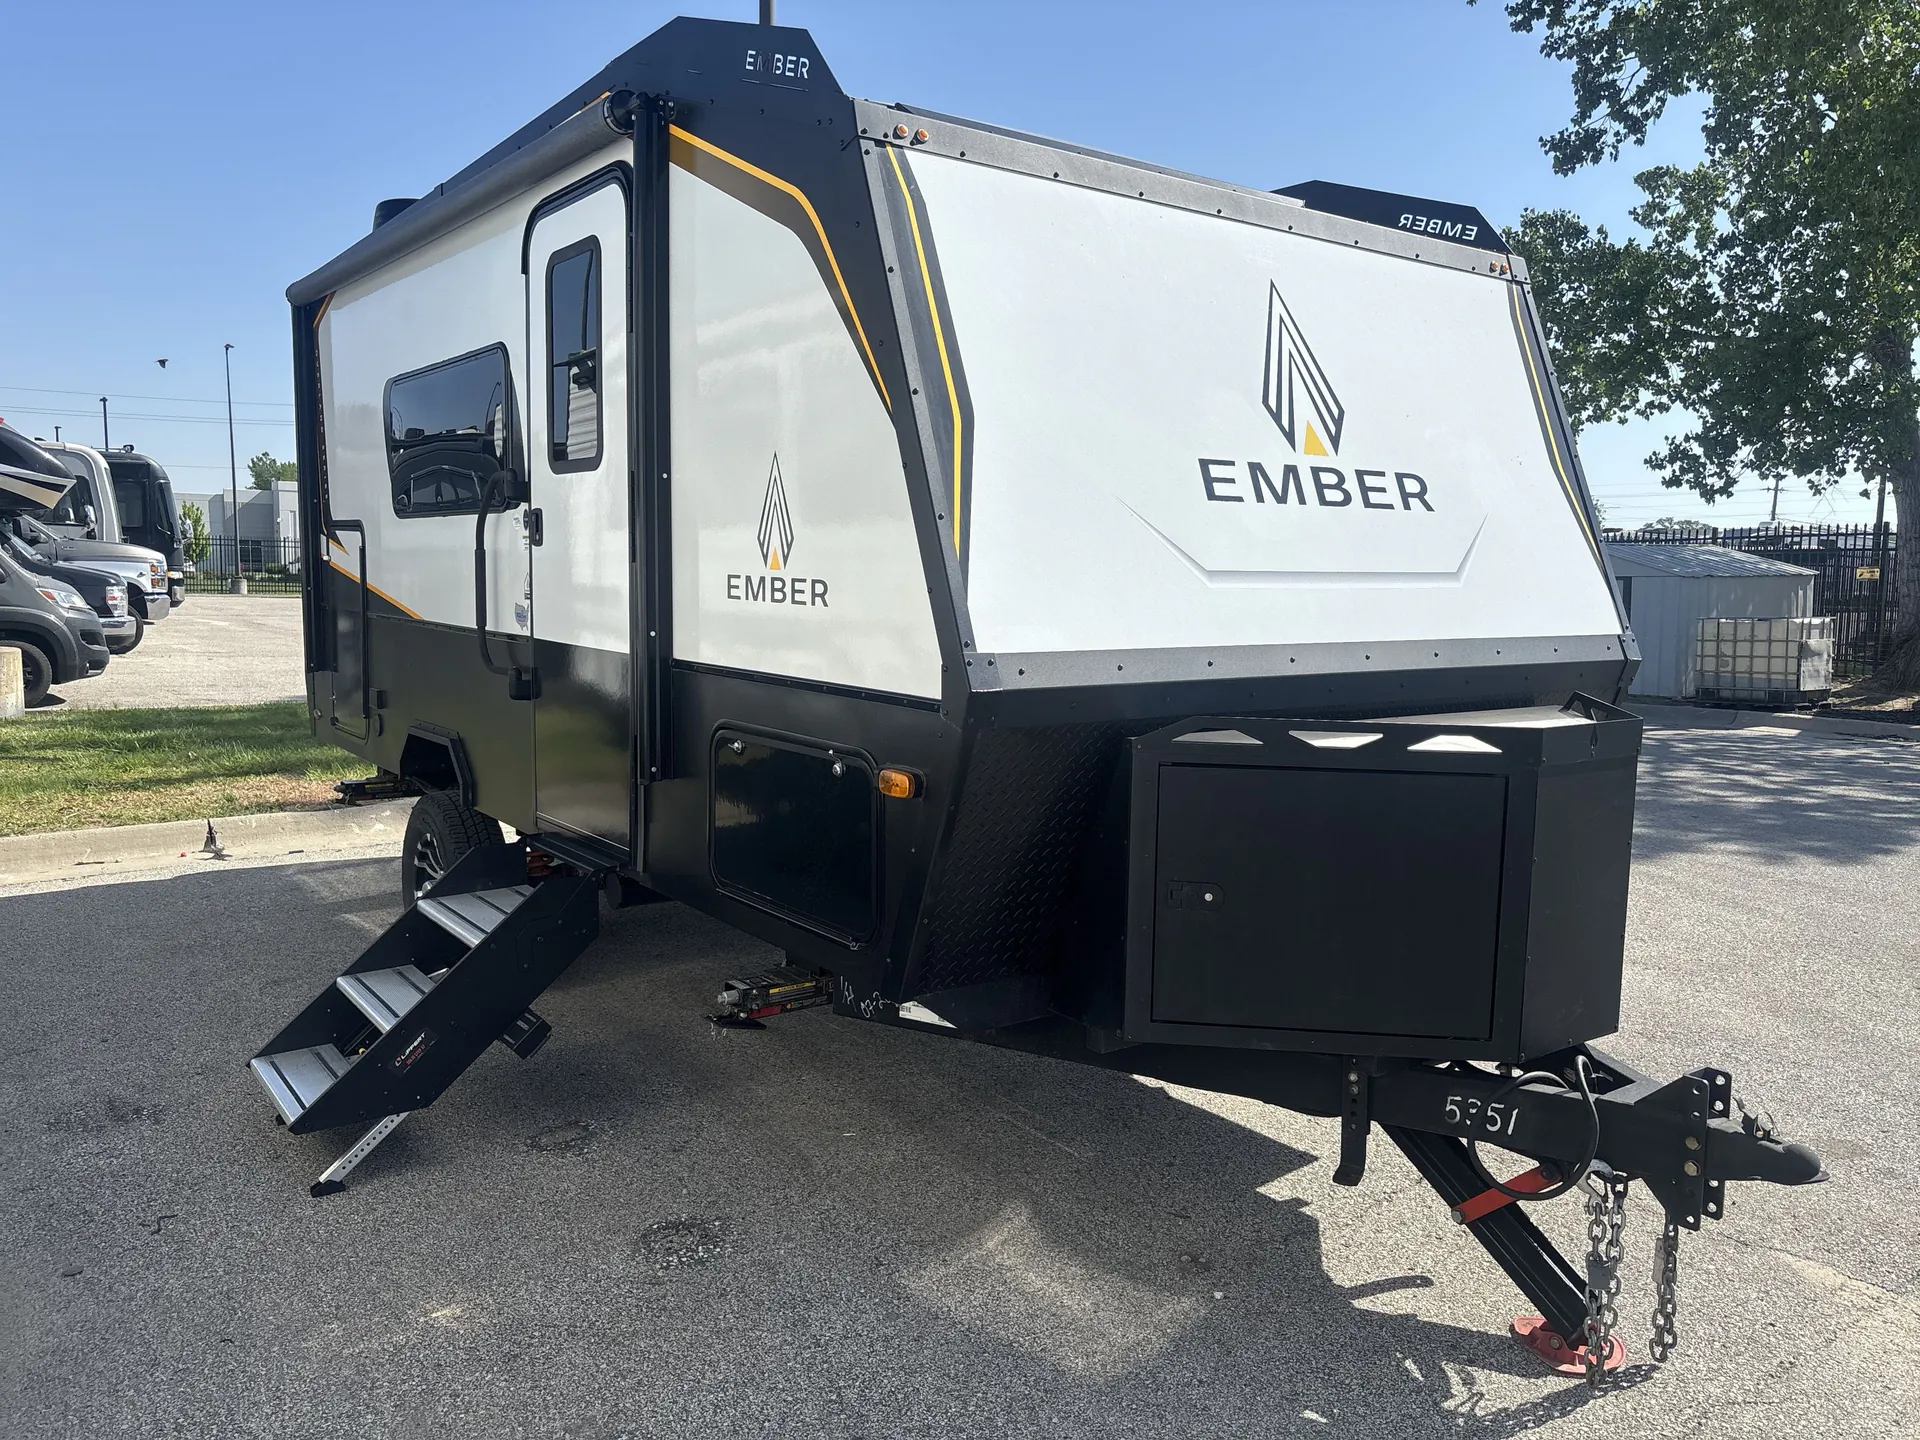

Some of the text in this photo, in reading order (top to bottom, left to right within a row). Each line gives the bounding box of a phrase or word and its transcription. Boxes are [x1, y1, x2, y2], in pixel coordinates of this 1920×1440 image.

[745, 49, 810, 79] EMBER
[1198, 458, 1436, 512] EMBER
[727, 574, 829, 607] EMBER
[401, 1031, 426, 1060] LIPPERT
